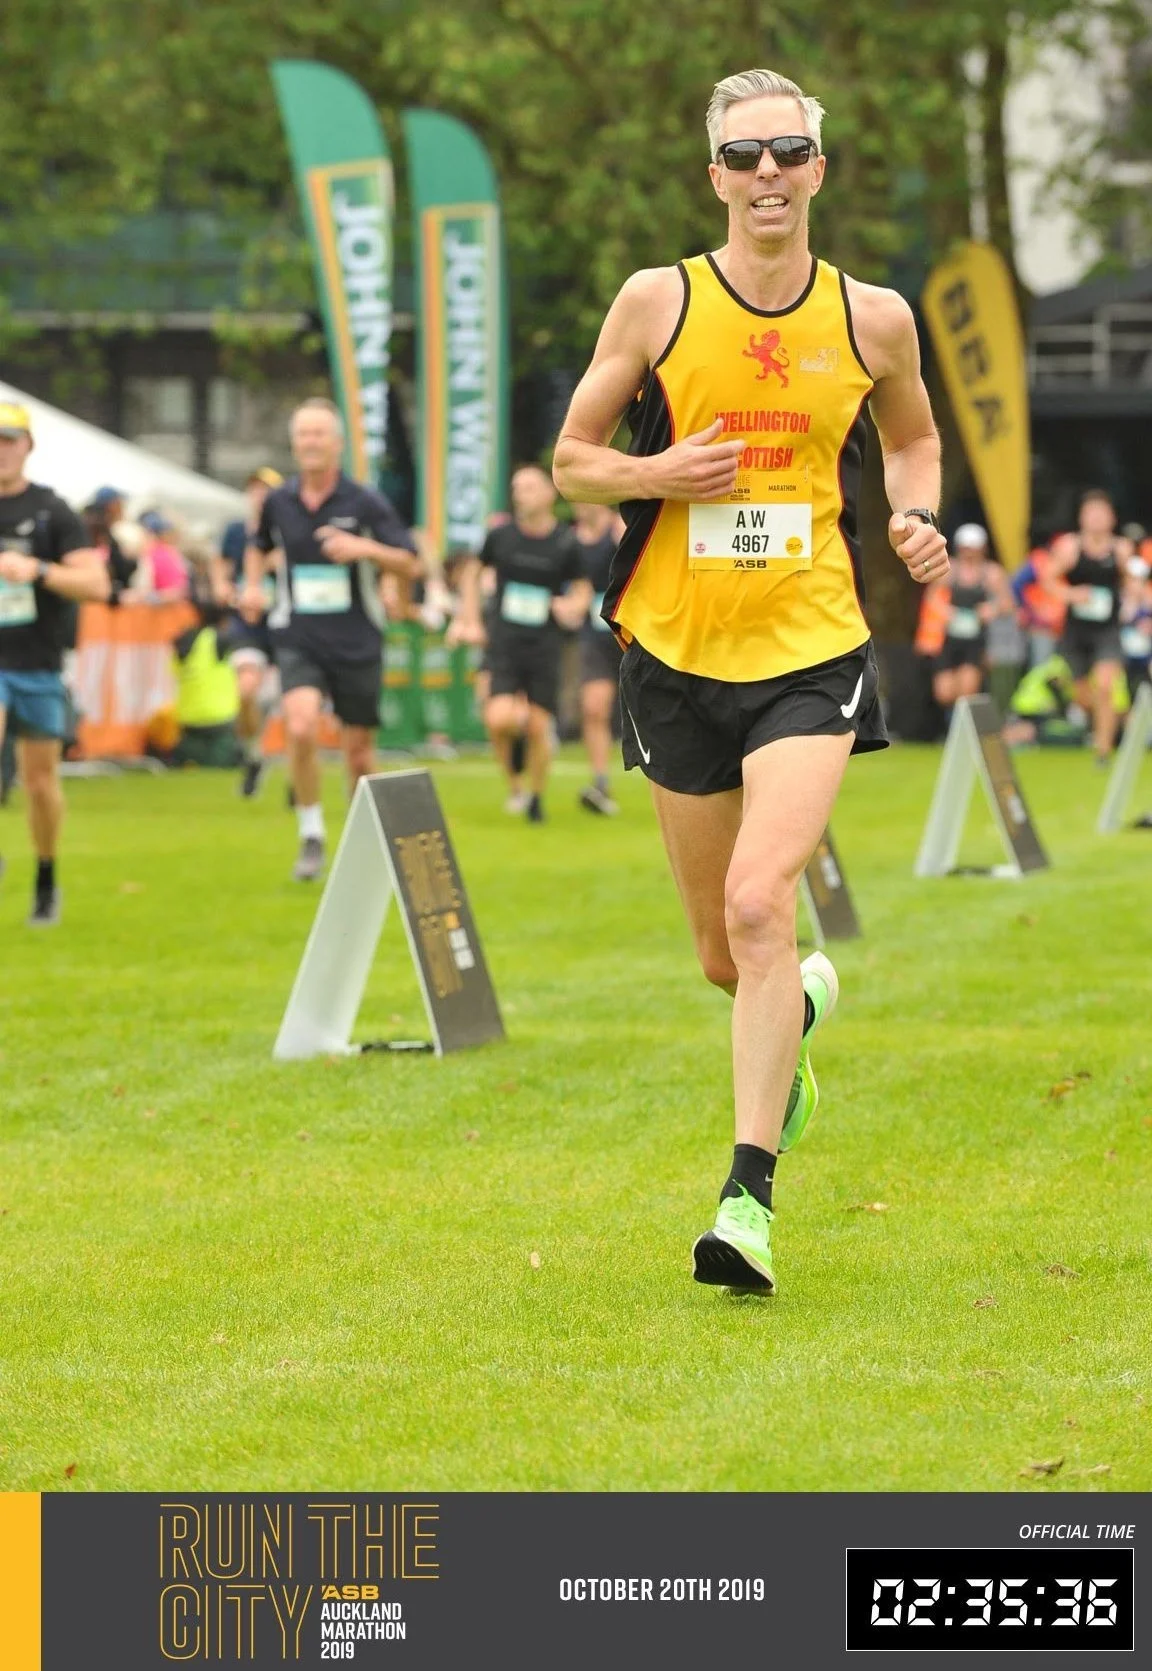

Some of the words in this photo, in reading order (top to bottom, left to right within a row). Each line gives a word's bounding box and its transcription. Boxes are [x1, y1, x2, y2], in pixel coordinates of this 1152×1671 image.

[333, 188, 392, 367] JOHN
[443, 228, 488, 390] JOHN
[768, 484, 797, 492] MARATHON
[736, 510, 746, 528] A
[750, 510, 766, 528] W
[731, 534, 770, 553] 4967
[734, 560, 768, 569] ASB
